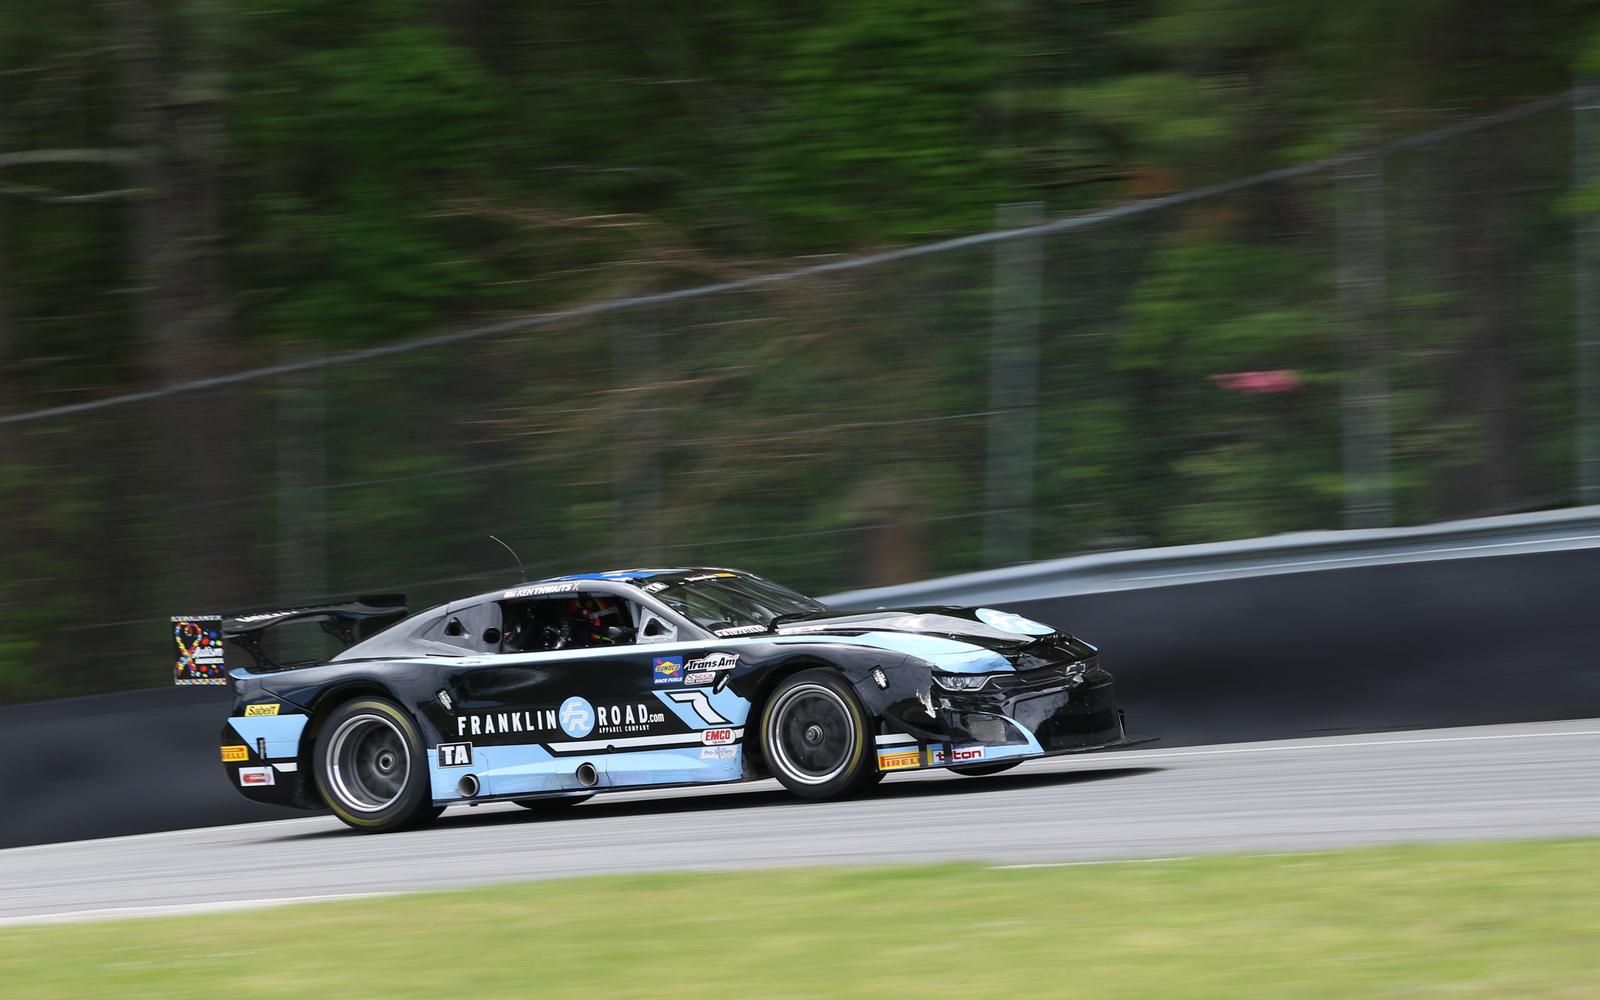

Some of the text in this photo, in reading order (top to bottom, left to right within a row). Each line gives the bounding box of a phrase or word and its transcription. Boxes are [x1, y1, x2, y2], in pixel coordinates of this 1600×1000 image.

[457, 709, 557, 736] FRANKLIN
[599, 726, 622, 734] APPAREL
[705, 729, 731, 741] EMCO
[441, 745, 469, 765] TA
